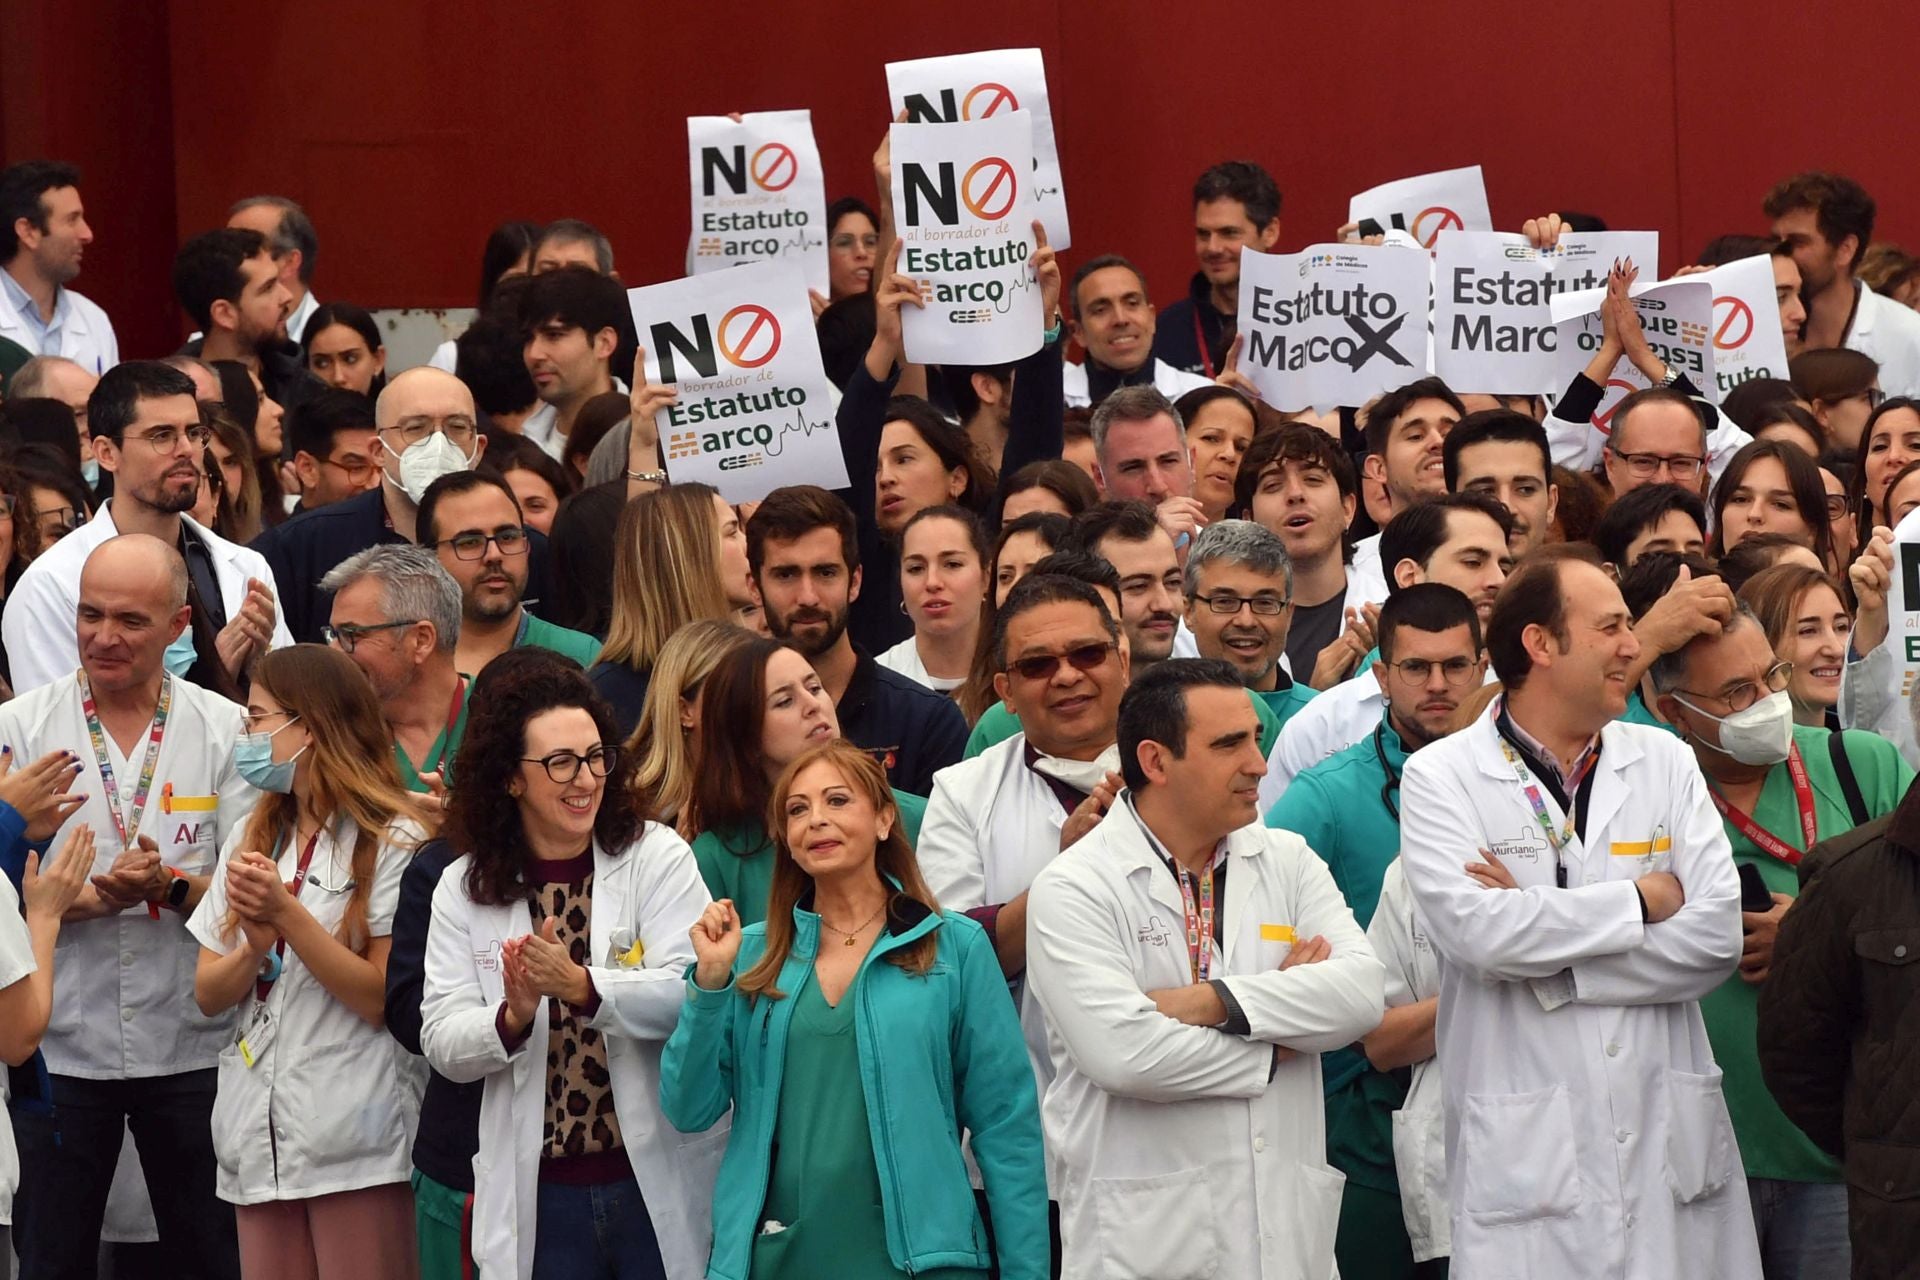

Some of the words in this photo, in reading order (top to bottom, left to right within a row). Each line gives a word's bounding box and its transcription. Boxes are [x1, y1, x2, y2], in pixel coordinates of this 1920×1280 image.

[703, 208, 809, 232] Estatuto
[907, 228, 918, 241] al
[924, 226, 990, 241] borrador
[995, 221, 1009, 234] de
[907, 240, 1028, 273] Estatuto
[1252, 282, 1397, 326] Estatuto
[684, 374, 750, 393] borrador
[757, 369, 774, 382] de
[667, 386, 806, 427] Estatuto
